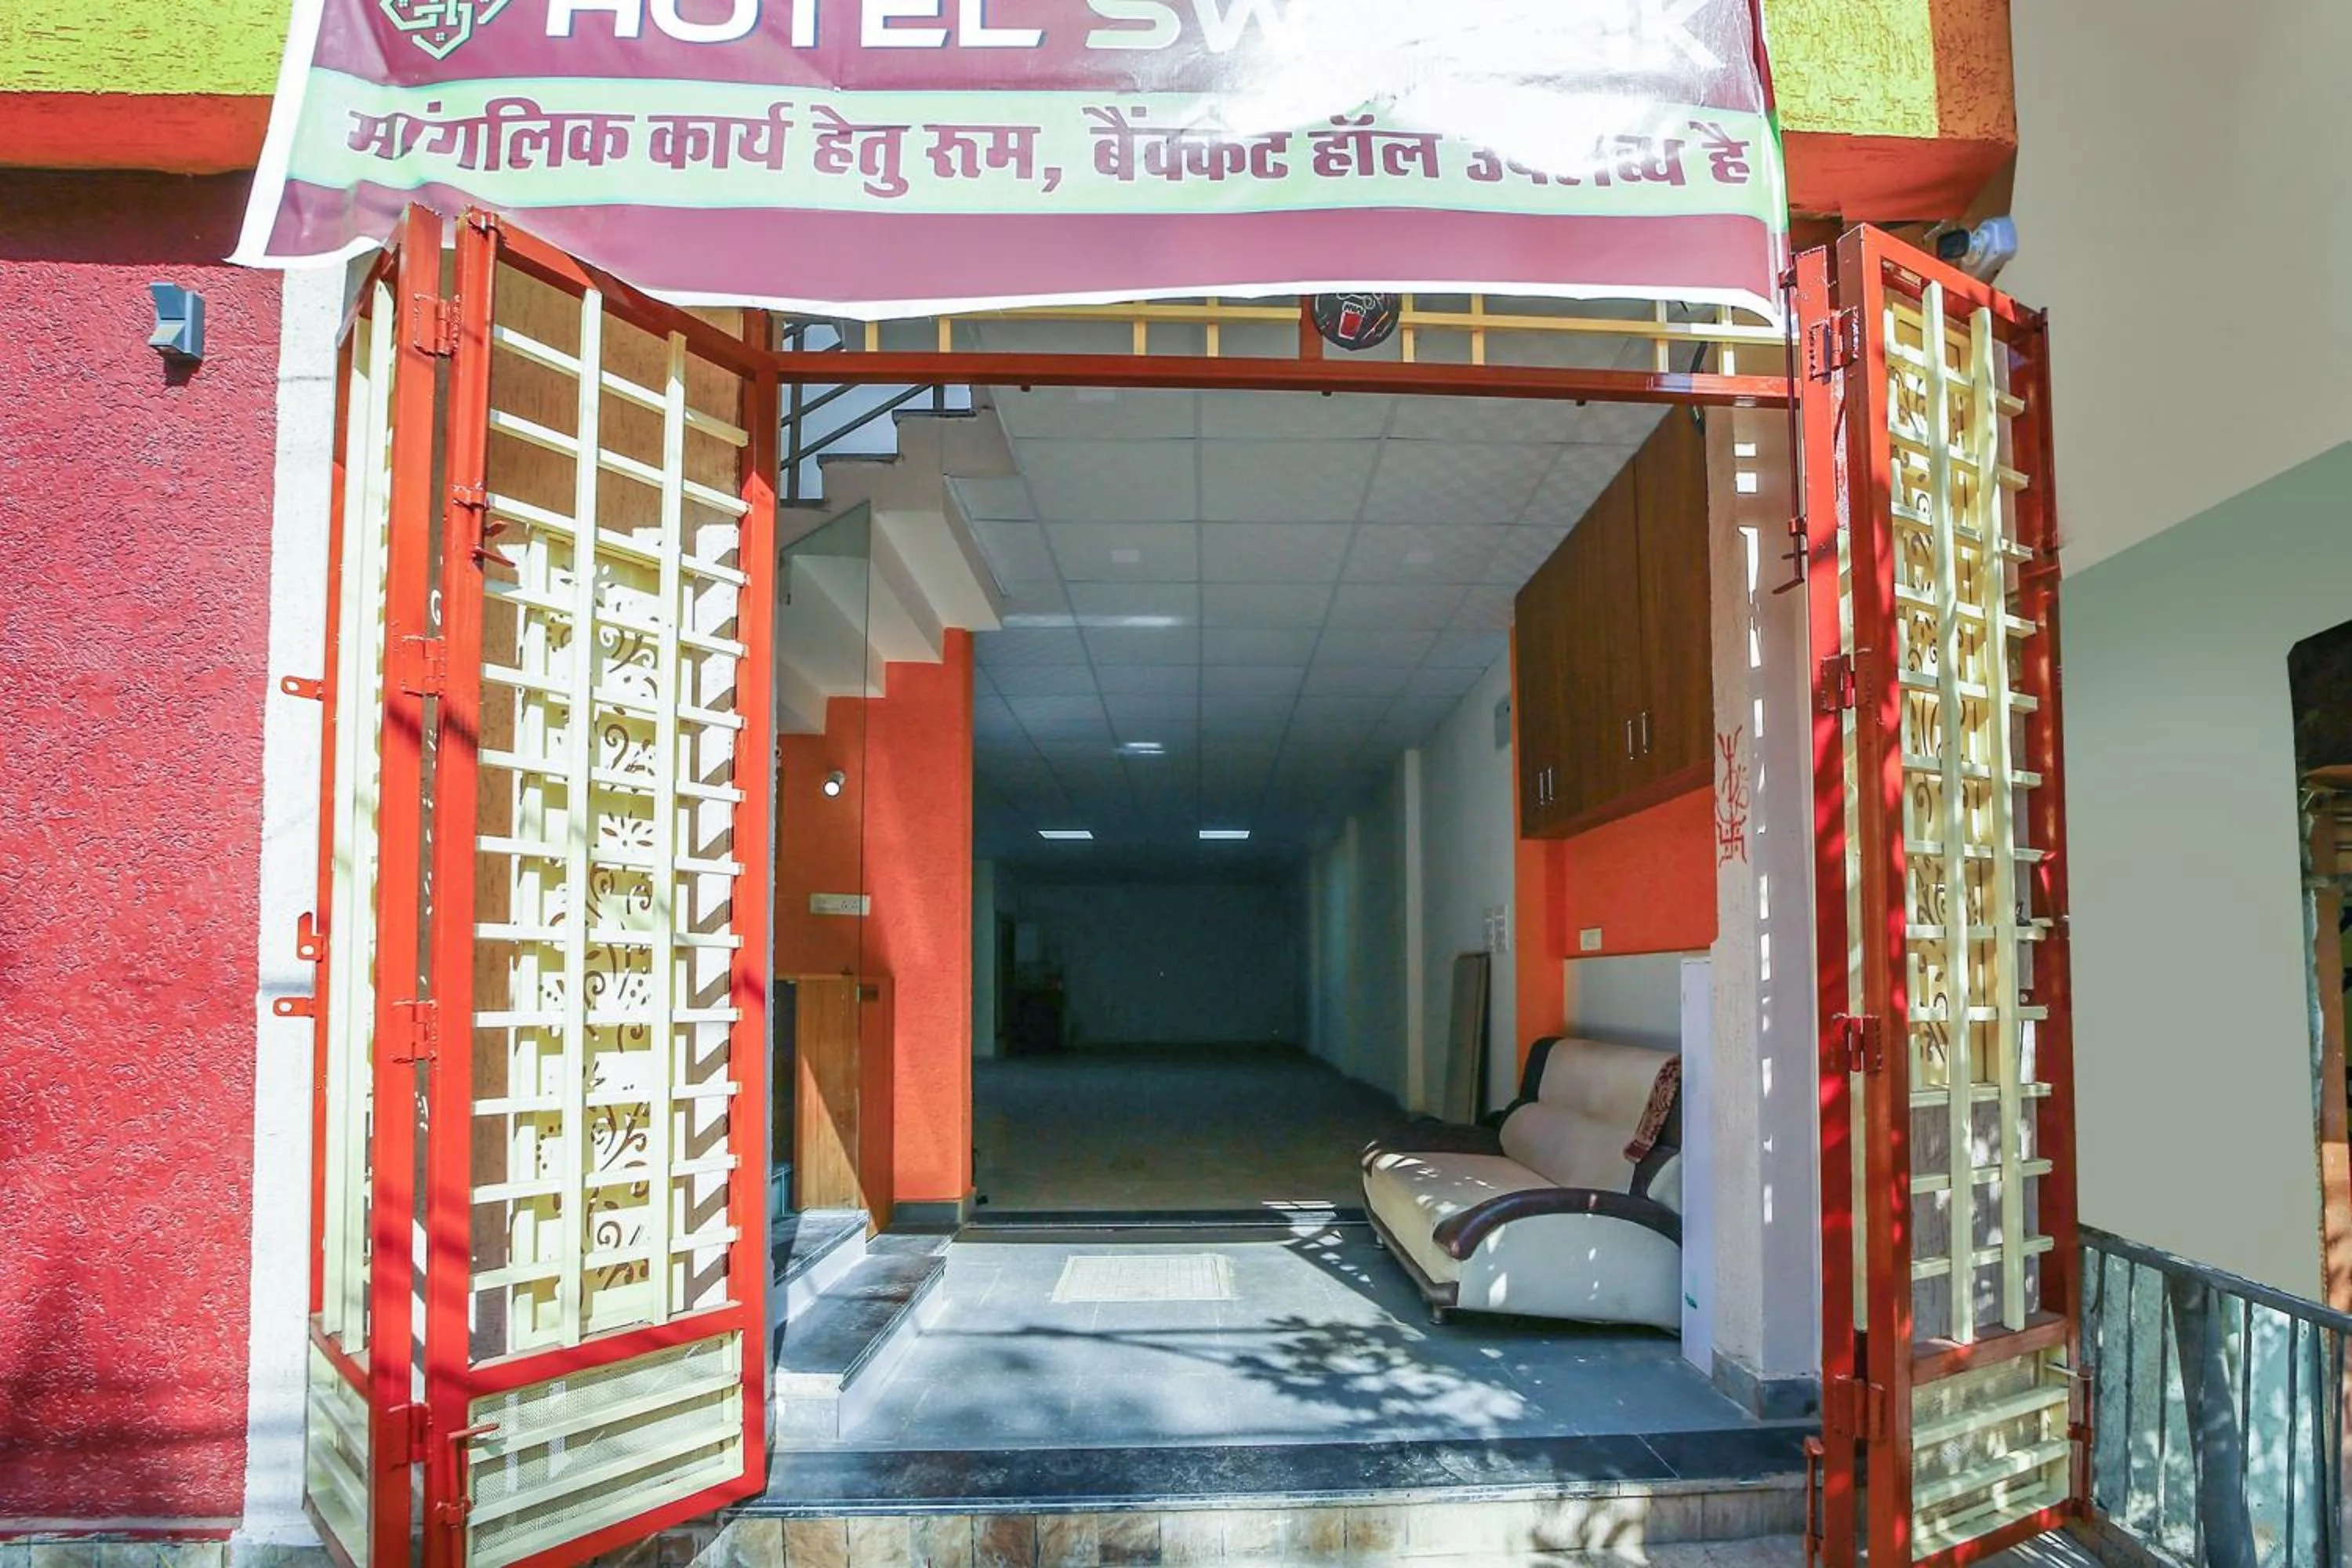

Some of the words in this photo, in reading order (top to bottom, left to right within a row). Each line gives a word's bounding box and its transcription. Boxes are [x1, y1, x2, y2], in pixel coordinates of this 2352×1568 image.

[347, 97, 635, 171] मांगलिक
[648, 101, 794, 170] कार्य
[810, 104, 912, 198] हेतु
[1308, 114, 1443, 179] हॉल
[1688, 120, 1751, 183] है
